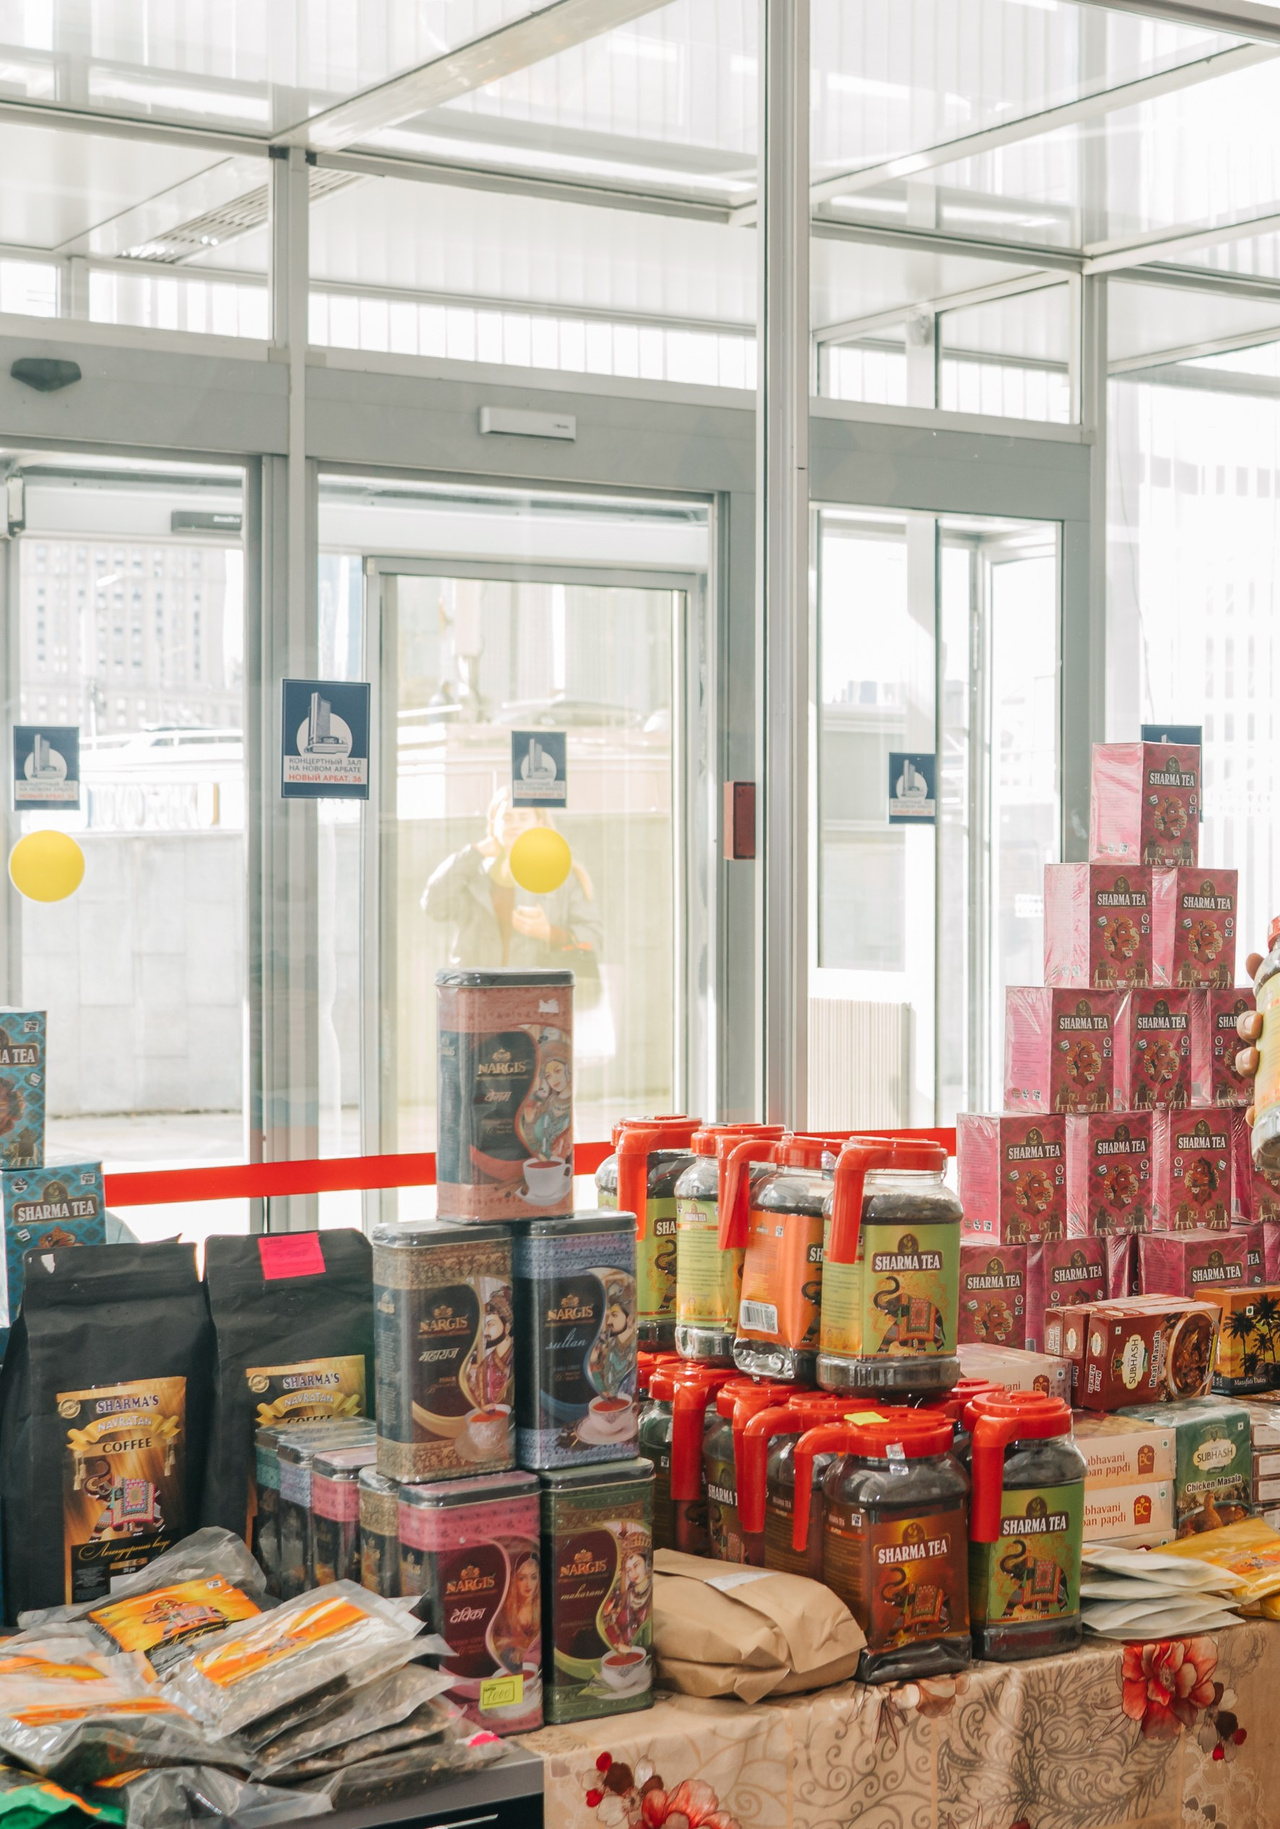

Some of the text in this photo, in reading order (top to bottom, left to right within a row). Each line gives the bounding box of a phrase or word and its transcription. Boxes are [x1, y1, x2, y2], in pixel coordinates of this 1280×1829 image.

[289, 758, 343, 766] КОНЦЕРТНЫЙ
[289, 773, 320, 781] НОВЫЙ
[1150, 773, 1195, 787] SHARMA TEA
[1097, 893, 1146, 906] SHARMA TEA
[1183, 896, 1231, 910] SHARMA TEA
[1059, 1017, 1108, 1030] SHARMA TEA
[1137, 1016, 1186, 1029] SHARMA TEA
[1218, 1016, 1238, 1028] SHAR
[12, 1048, 36, 1063] TEA
[477, 1061, 527, 1075] NARGIS
[1097, 1139, 1146, 1155] SHARMA TEA
[1178, 1136, 1226, 1149] SHARMA TEA
[1008, 1144, 1061, 1159] SHARMA TEA
[17, 1200, 96, 1222] SHARMA TEA
[656, 1220, 677, 1235] SHA
[874, 1254, 941, 1271] SHARMA TEA
[1054, 1264, 1102, 1282] SHARMA TEA
[1192, 1264, 1241, 1282] SHARMA TEA
[967, 1275, 1021, 1290] SHARMA TEA
[547, 1305, 594, 1321] NARGIS
[419, 1317, 468, 1332] NARGIS
[545, 1327, 587, 1349] sultan
[1128, 1338, 1139, 1385] SUBHASH
[1149, 1331, 1160, 1387] Meat Masala
[283, 1373, 340, 1390] SHARMA'S
[96, 1395, 159, 1414] SHARMA'S
[283, 1392, 334, 1407] NAVRATAN
[97, 1415, 152, 1432] NAVRATAN
[102, 1437, 152, 1454] COFFEE
[1139, 1453, 1152, 1466] BC
[1197, 1447, 1233, 1463] SUBHASH
[1105, 1462, 1131, 1478] papdi
[1186, 1474, 1242, 1493] Chicken Masala
[708, 1483, 734, 1506] SHARMA
[1136, 1503, 1149, 1516] BC
[1002, 1515, 1067, 1535] SHARMA TEA
[1101, 1512, 1126, 1527] papdi
[878, 1539, 948, 1564] SHARMA TEA
[560, 1559, 607, 1577] NARGIS
[446, 1576, 496, 1594] NARGIS
[560, 1583, 605, 1600] maharani
